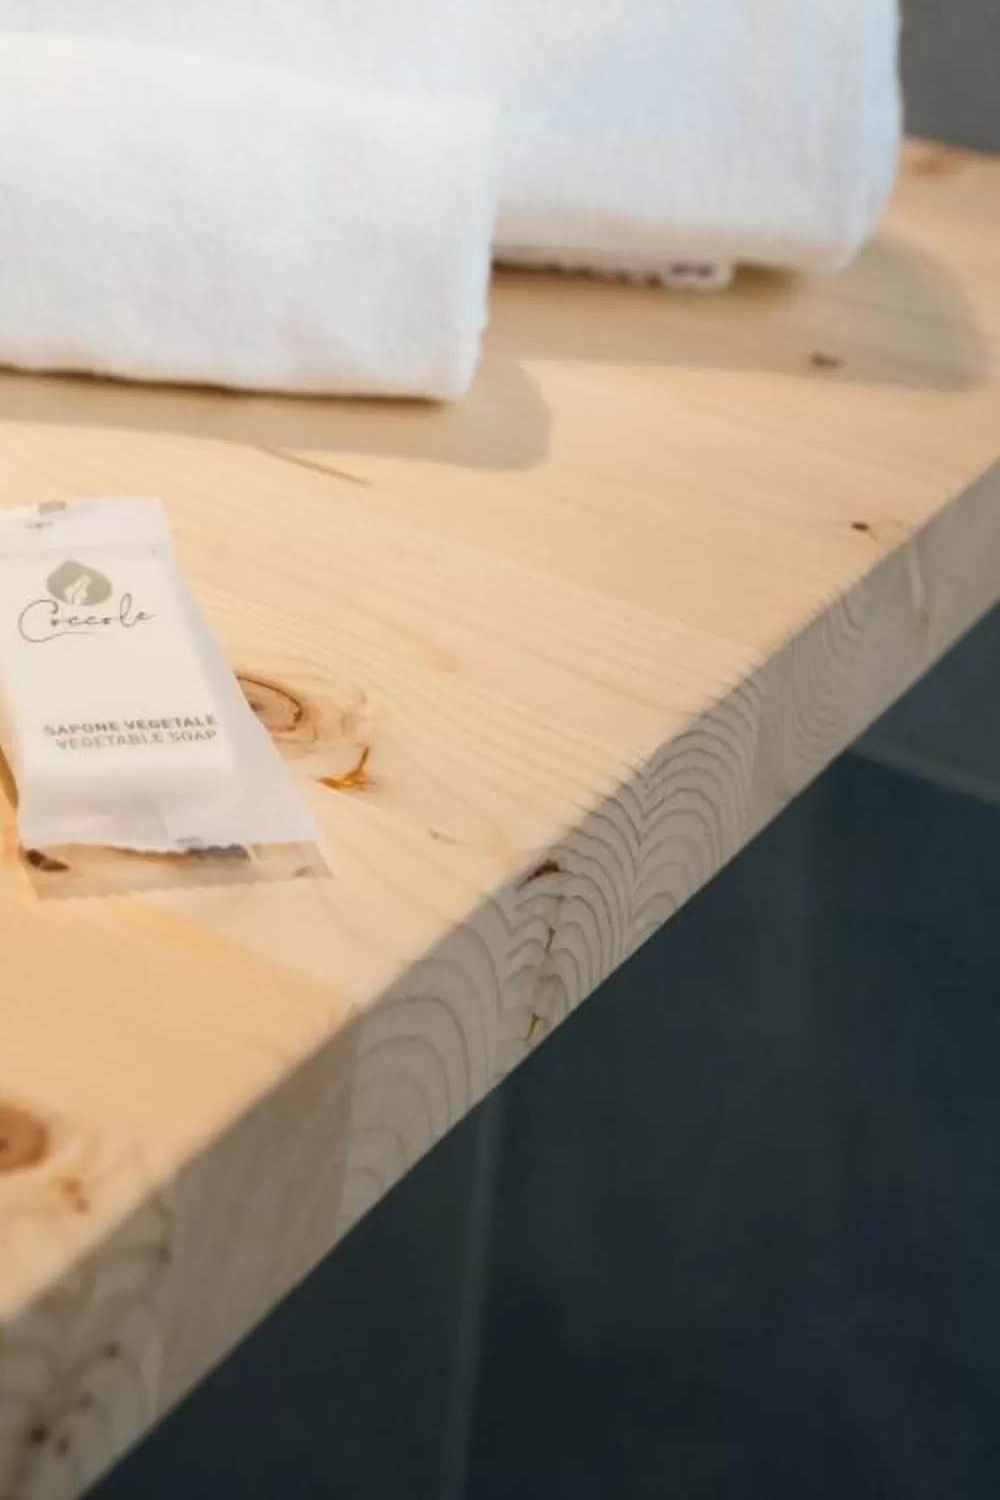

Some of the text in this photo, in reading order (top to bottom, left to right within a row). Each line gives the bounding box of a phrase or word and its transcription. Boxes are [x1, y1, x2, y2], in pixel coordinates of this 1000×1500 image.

[18, 592, 157, 643] Coccole
[43, 713, 217, 737] SAPONE VEGETALE
[56, 727, 217, 750] VEGETABLE SOAP
